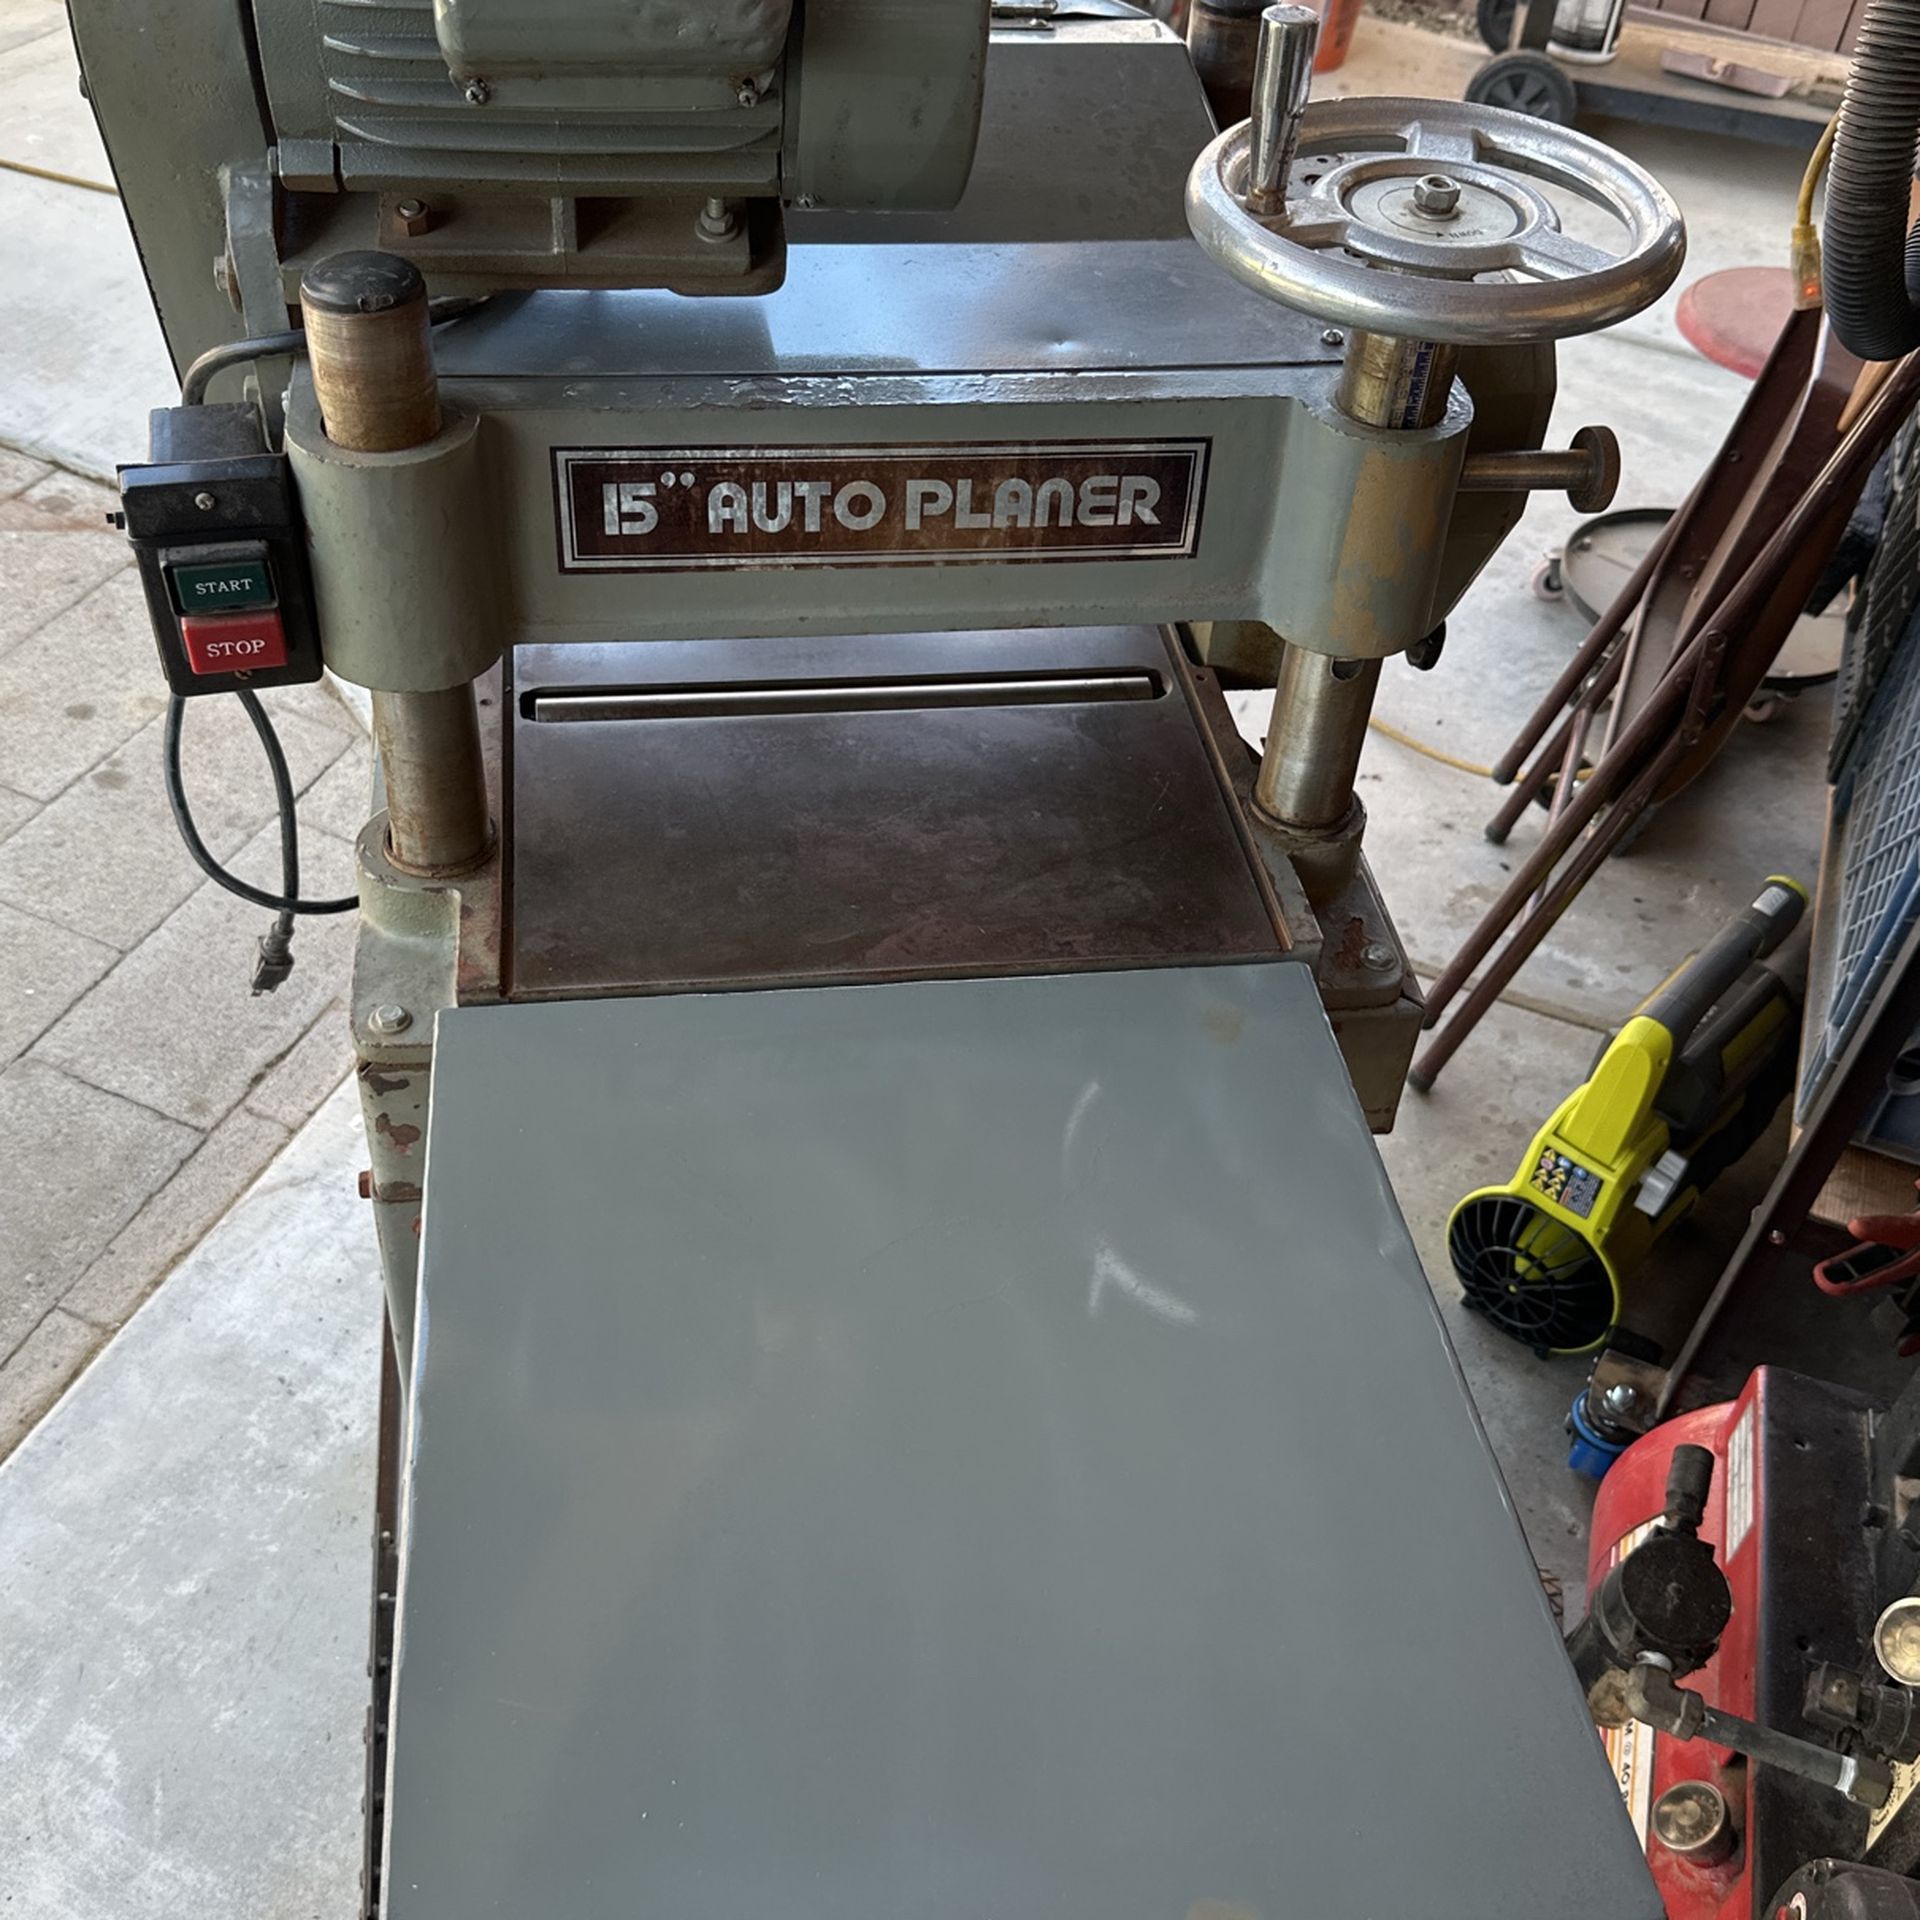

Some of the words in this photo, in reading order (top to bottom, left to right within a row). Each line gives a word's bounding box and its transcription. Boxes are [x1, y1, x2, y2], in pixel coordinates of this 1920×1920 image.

[707, 480, 887, 534] AUTO
[904, 475, 1162, 531] PLANER
[195, 578, 254, 596] START
[206, 639, 266, 658] STOP
